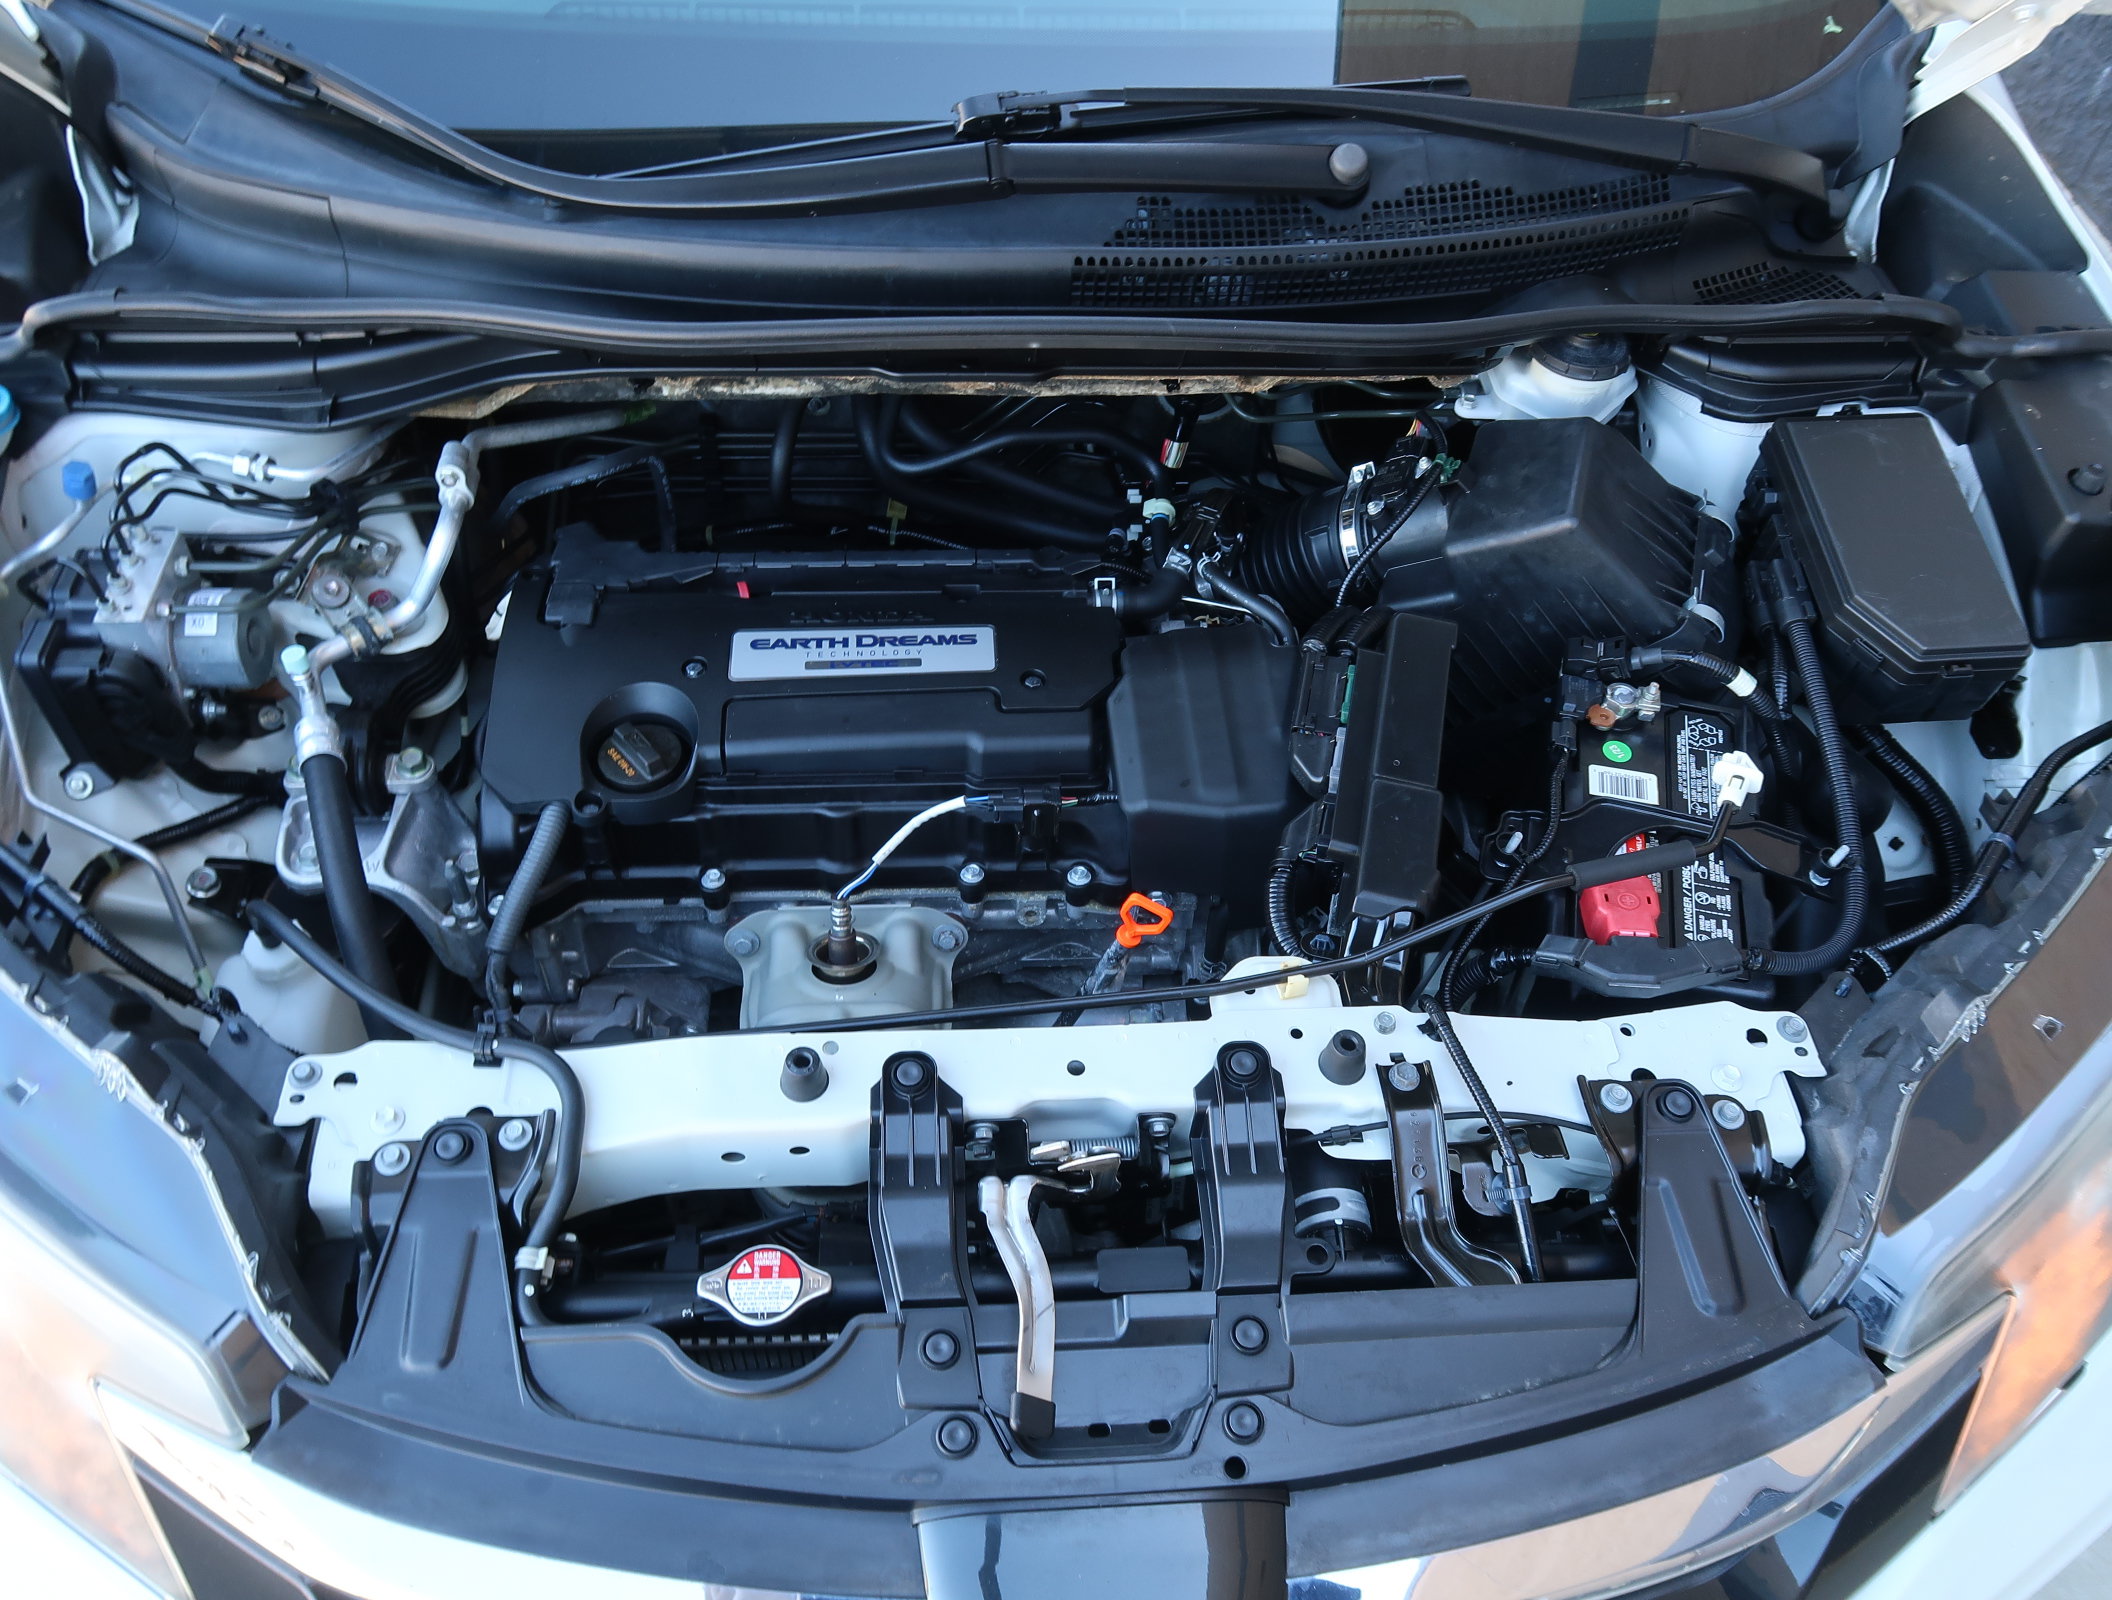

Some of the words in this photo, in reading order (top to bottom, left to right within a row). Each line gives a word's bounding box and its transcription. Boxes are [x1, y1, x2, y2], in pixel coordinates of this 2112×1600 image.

[750, 636, 849, 650] EARTH
[856, 634, 978, 648] DREAMS
[806, 649, 923, 658] TECHNOLOGY
[1683, 897, 1693, 931] DANGER
[754, 1251, 781, 1259] DANGER
